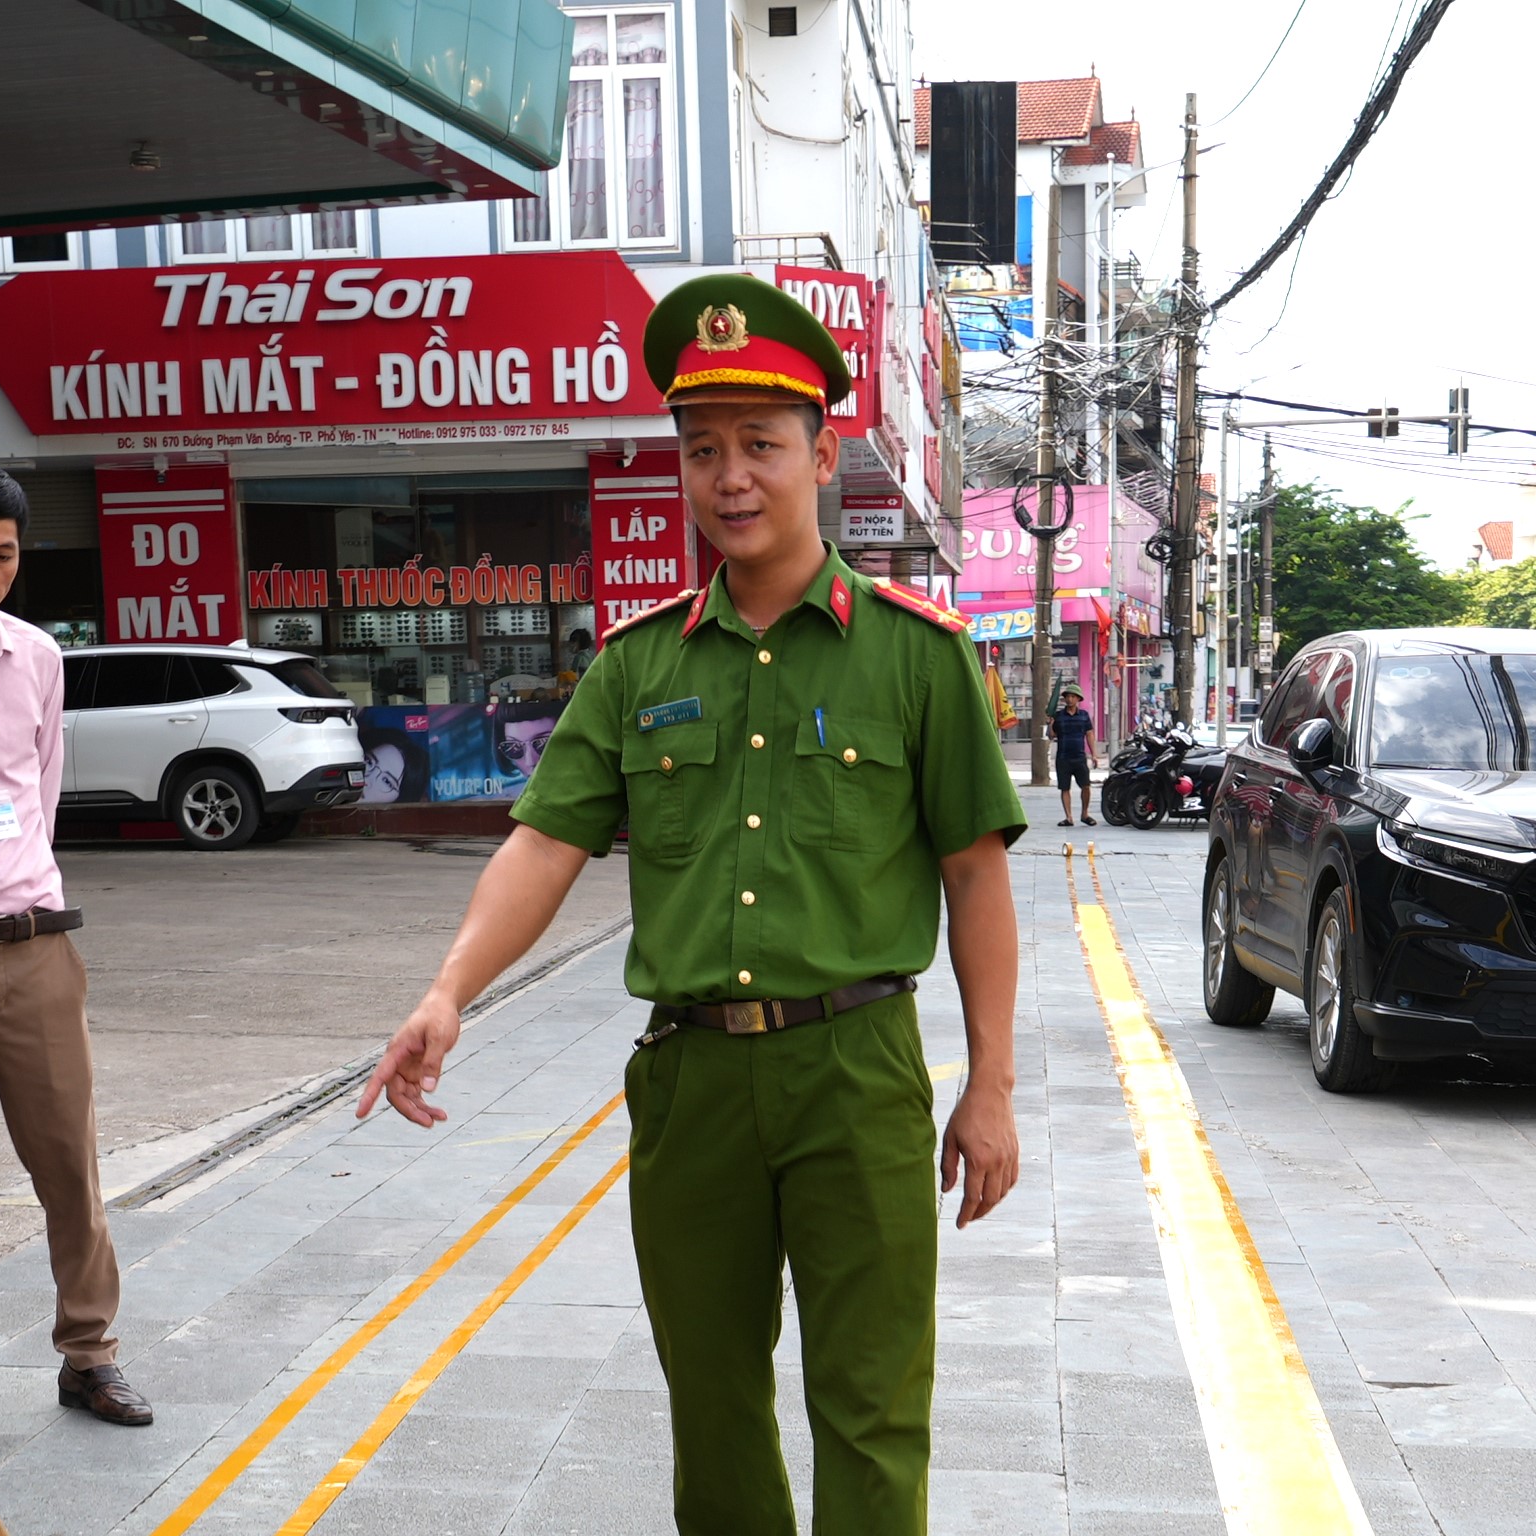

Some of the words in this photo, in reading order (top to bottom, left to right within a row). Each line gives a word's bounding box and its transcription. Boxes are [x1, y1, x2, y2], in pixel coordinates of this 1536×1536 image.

[154, 269, 315, 328] Thái
[315, 267, 473, 322] Sơn
[49, 350, 182, 422] KÍNH
[201, 333, 325, 414] MẮT
[336, 376, 359, 391] -
[376, 326, 531, 410] ĐỒNG
[553, 322, 630, 405] HỒ
[143, 437, 157, 448] SN
[163, 437, 179, 448] 670
[217, 434, 242, 447] Phạm
[318, 425, 336, 442] Phổ
[398, 428, 434, 439] Hotline:
[436, 427, 457, 438] 0912
[460, 427, 476, 437] 975
[480, 426, 497, 437] 033
[504, 425, 526, 436] 0972
[529, 424, 547, 436] 767
[552, 423, 569, 435] 845
[610, 507, 667, 542] LẮP
[849, 528, 868, 536] RÚT
[864, 515, 886, 525] NỘP
[131, 522, 200, 567] ĐO
[248, 562, 328, 609] KÍNH
[336, 553, 446, 607] THUỐC
[449, 552, 542, 606] ĐỒNG
[549, 551, 594, 604] HỒ
[604, 553, 677, 585] KÍNH
[117, 577, 225, 640] MẮT
[484, 777, 503, 794] ON
